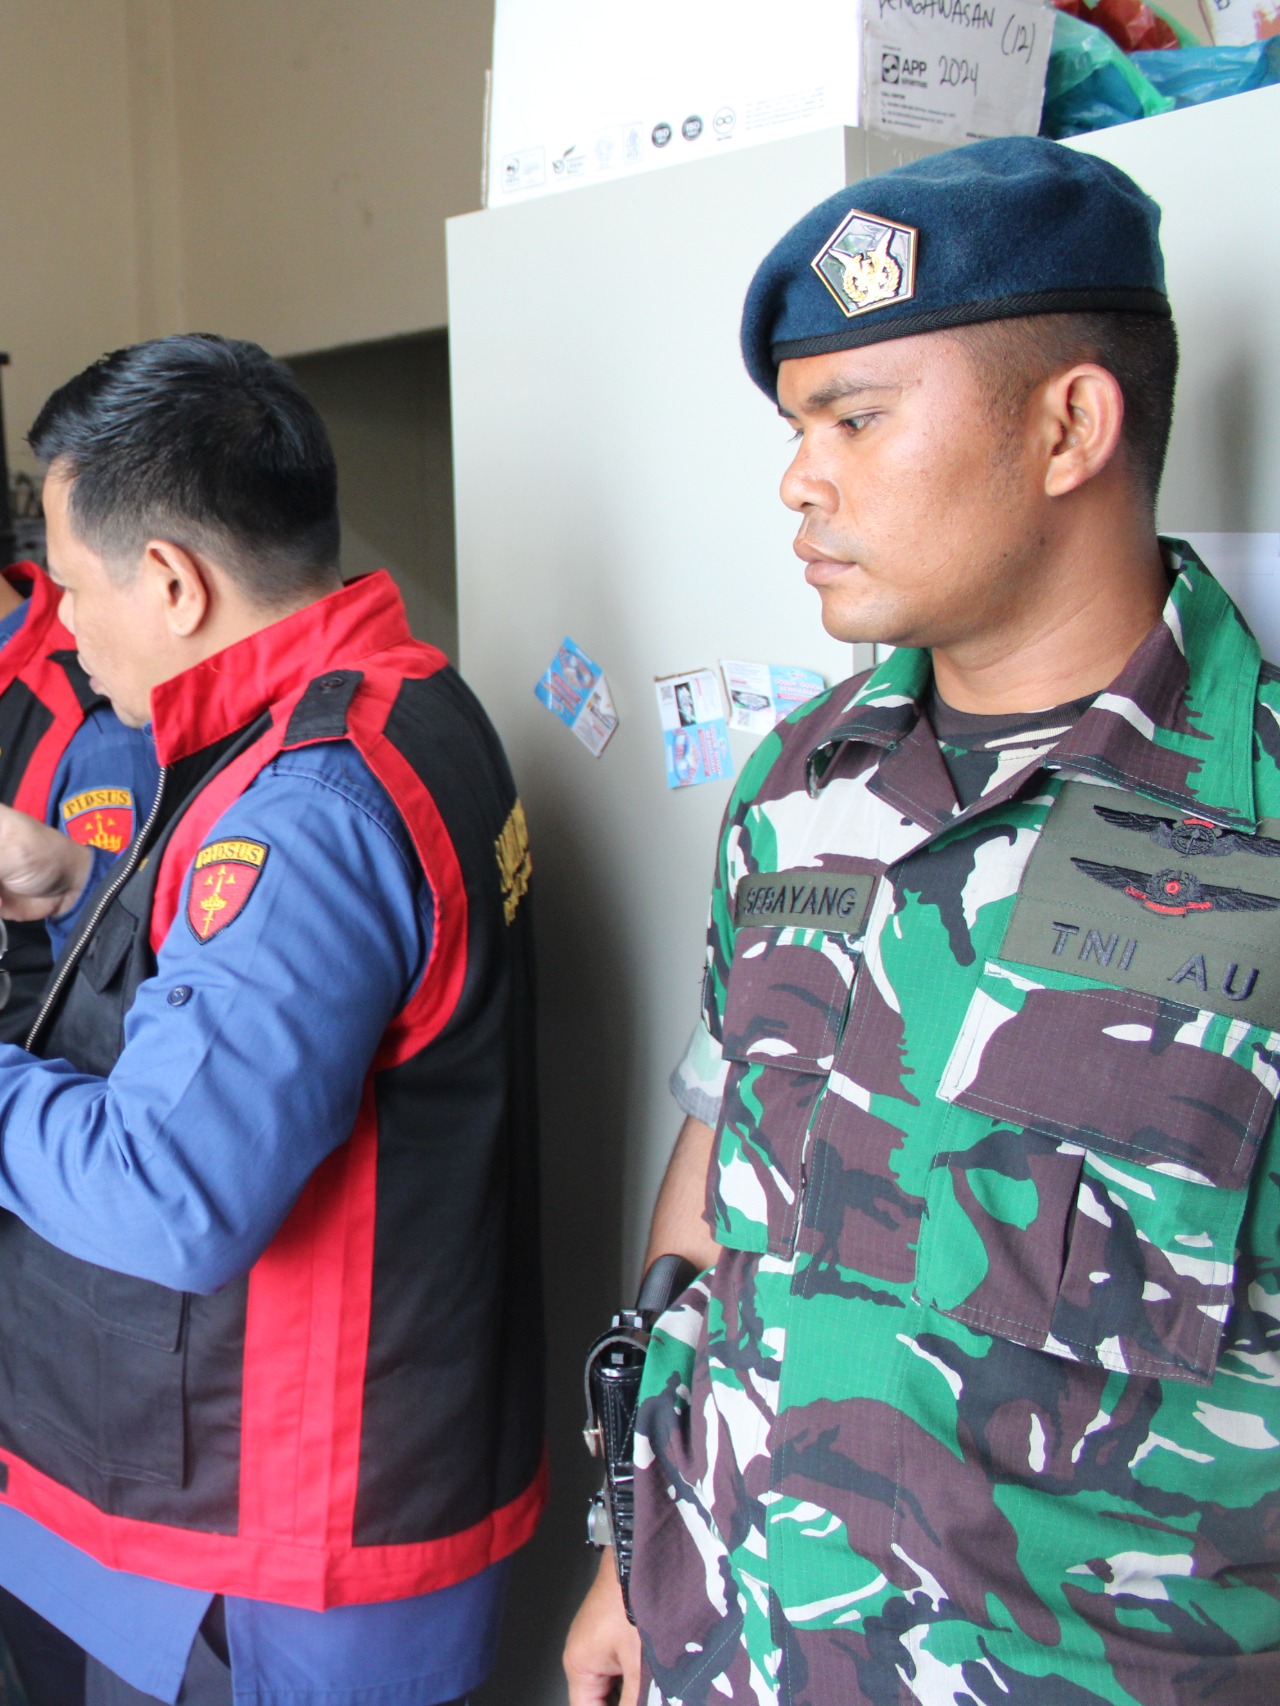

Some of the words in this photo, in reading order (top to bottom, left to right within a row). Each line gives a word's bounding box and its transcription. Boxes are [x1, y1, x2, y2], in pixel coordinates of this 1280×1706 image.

[1001, 14, 1036, 65] (12)
[901, 58, 928, 77] APP
[938, 55, 980, 96] 2024
[65, 790, 129, 816] PIDSUS
[744, 885, 858, 918] SEBAYANG
[1051, 921, 1138, 971] TNI
[1167, 952, 1260, 1001] AU
